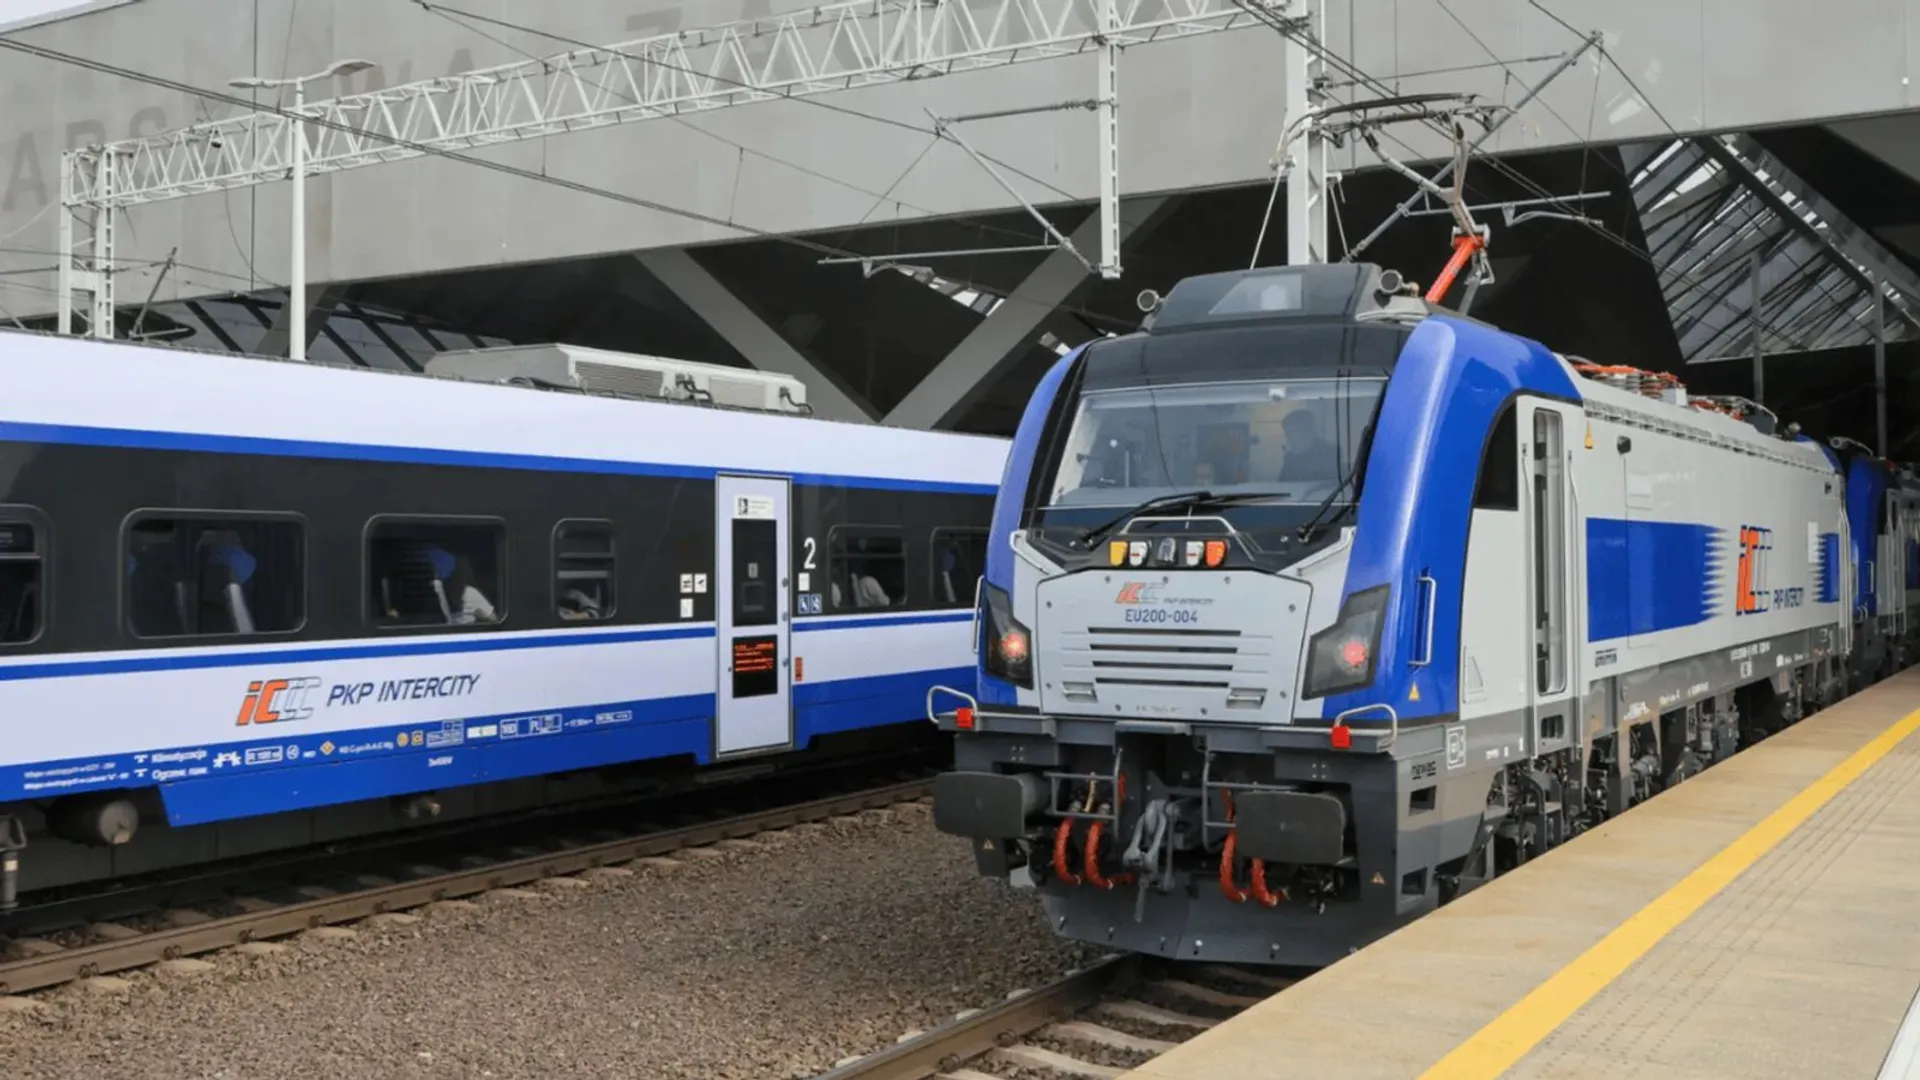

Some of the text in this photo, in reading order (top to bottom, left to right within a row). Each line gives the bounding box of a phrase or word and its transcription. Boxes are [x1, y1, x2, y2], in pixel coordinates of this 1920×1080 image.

[803, 537, 816, 570] 2
[1125, 608, 1199, 624] EU200-004
[326, 674, 481, 708] PKP INTERCITY
